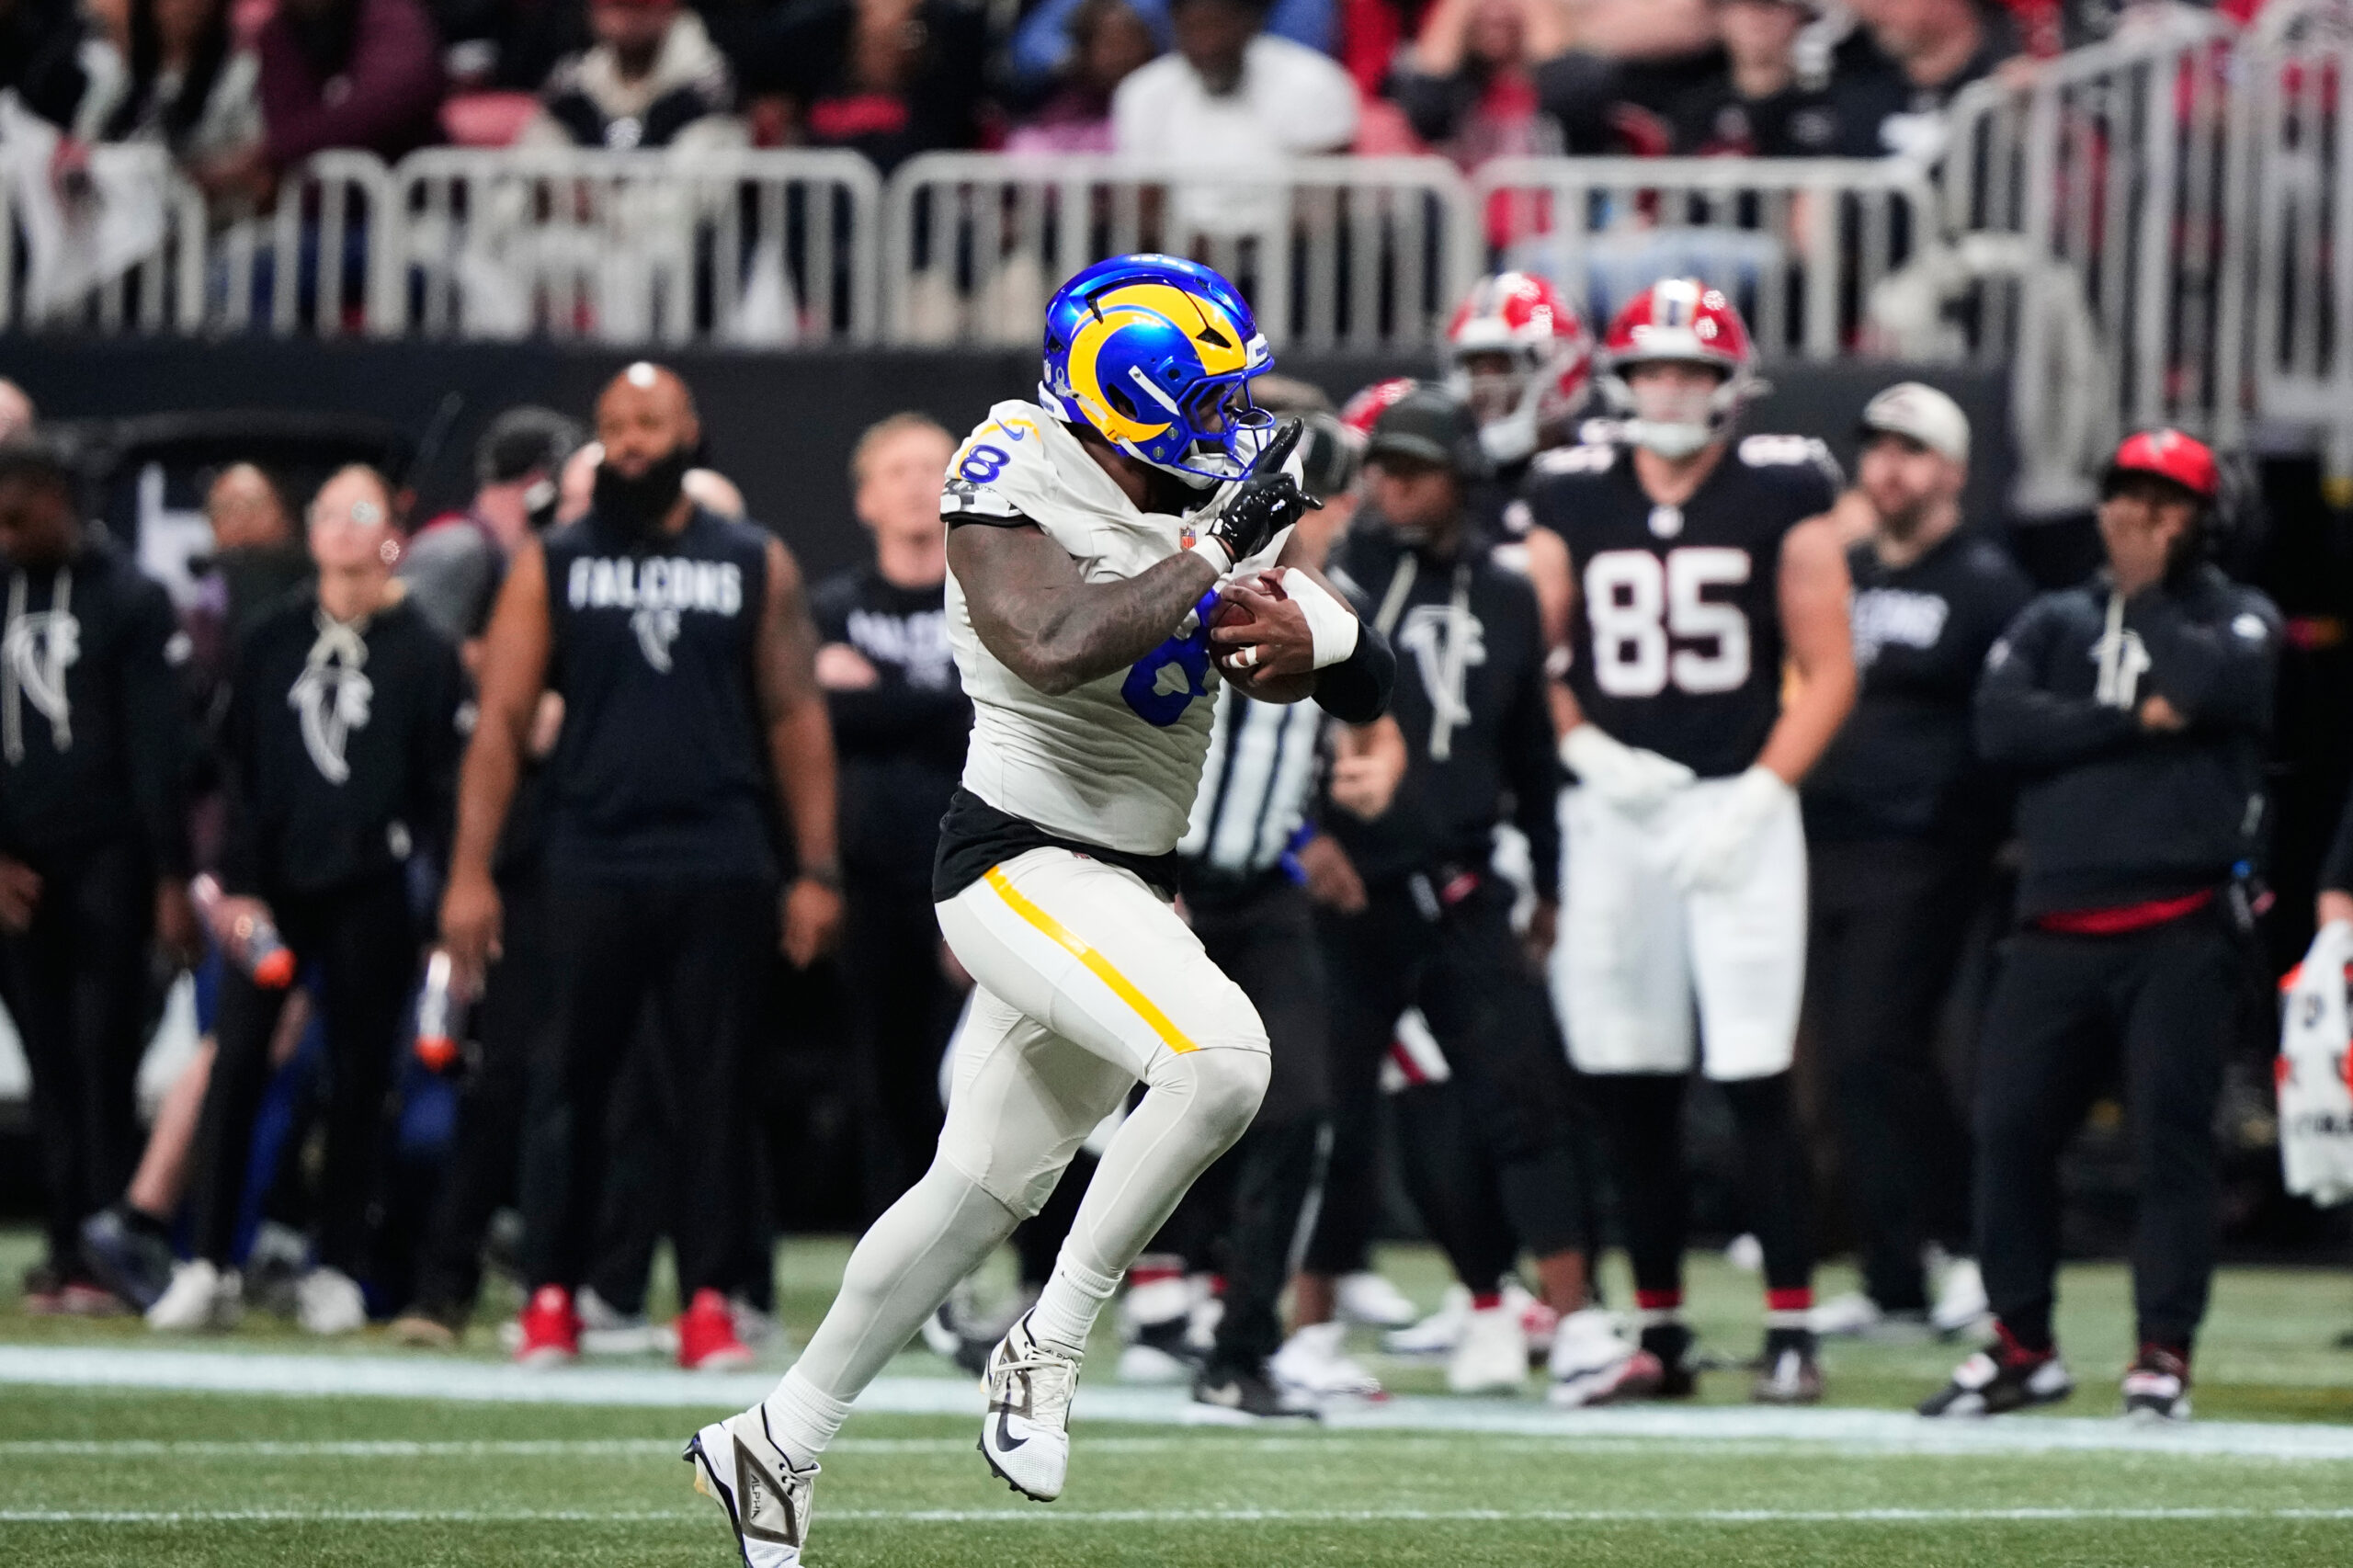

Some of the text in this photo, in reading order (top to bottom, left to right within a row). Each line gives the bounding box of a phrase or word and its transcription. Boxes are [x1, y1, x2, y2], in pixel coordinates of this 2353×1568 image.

[960, 445, 1011, 483] 8
[569, 557, 743, 617] FALCONS
[1584, 547, 1752, 697] 85
[750, 1473, 761, 1519] ALPHA
